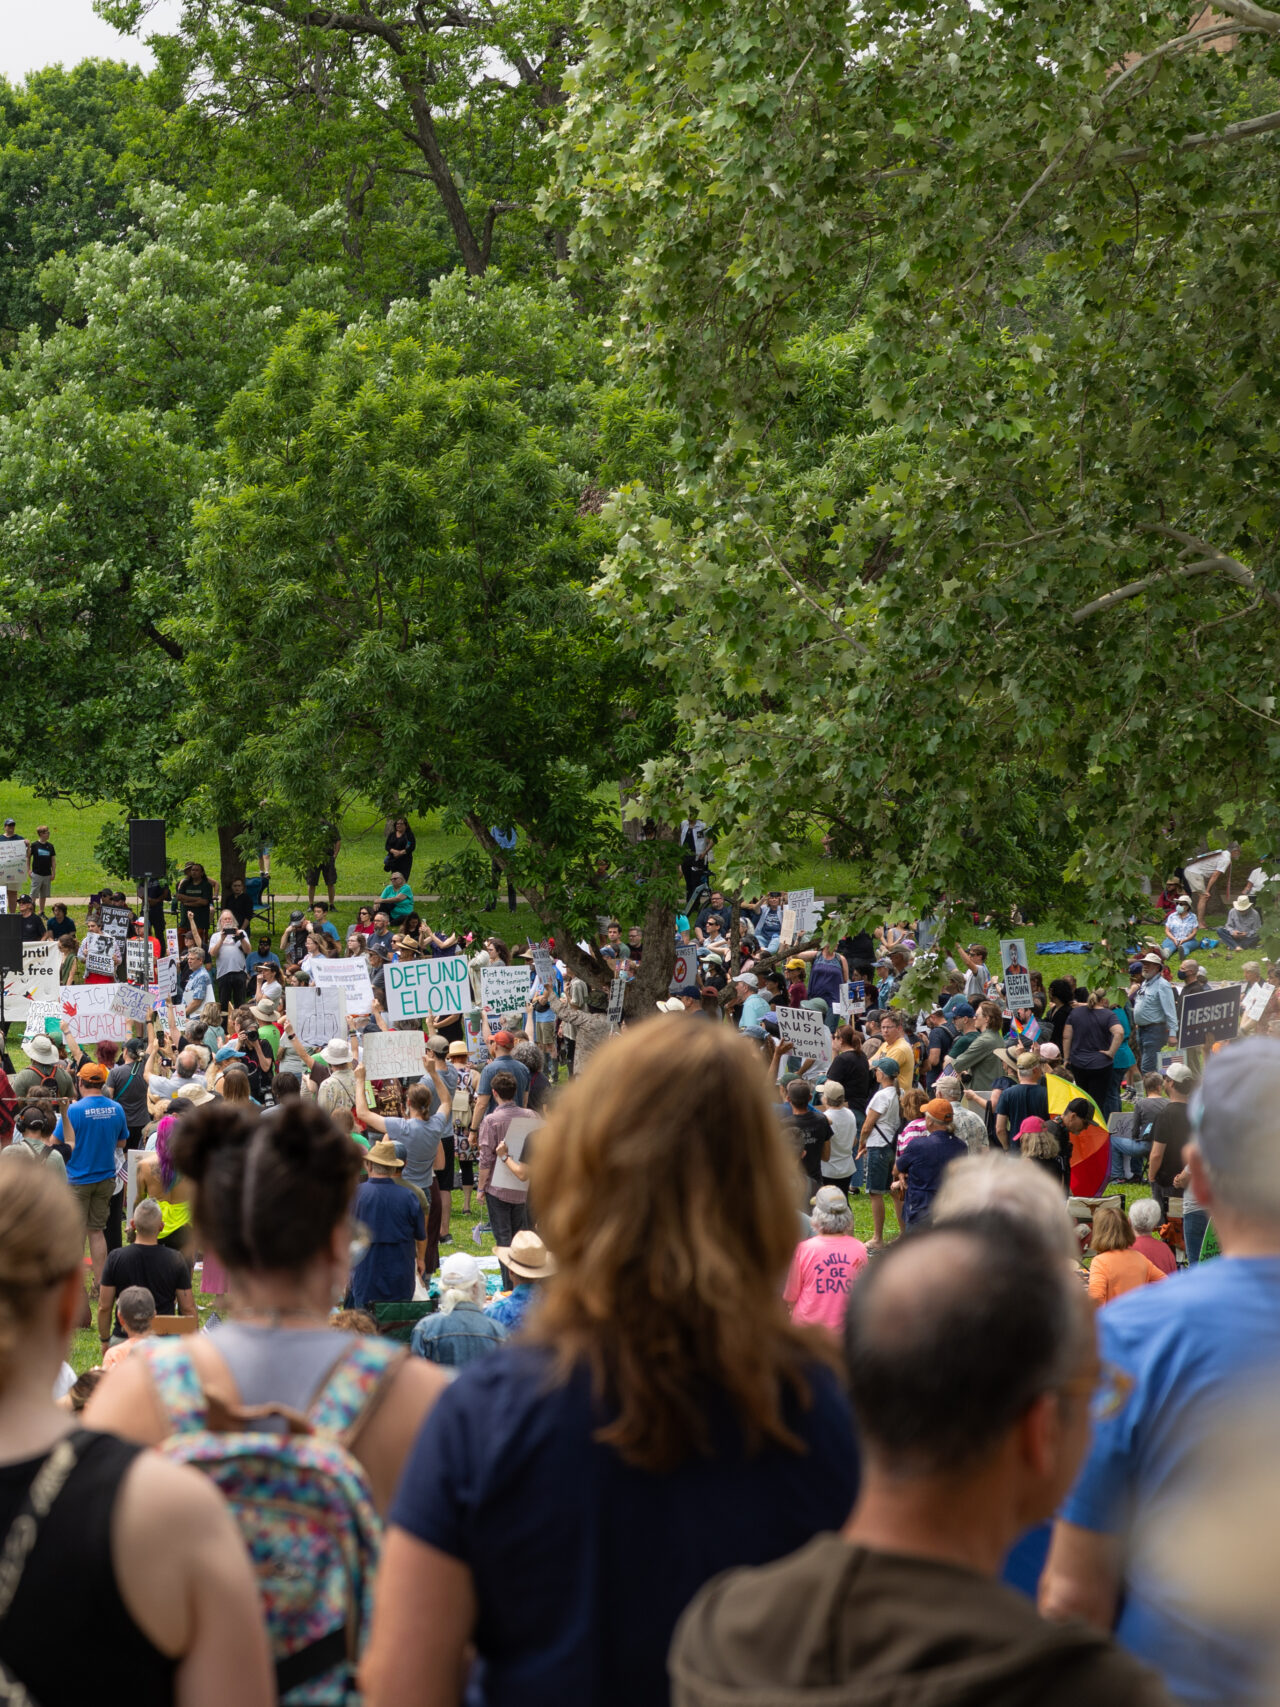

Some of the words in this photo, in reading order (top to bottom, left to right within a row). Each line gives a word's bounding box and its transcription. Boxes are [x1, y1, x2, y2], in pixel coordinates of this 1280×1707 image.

[102, 914, 111, 923] IS
[112, 908, 130, 917] ENEMY
[119, 917, 128, 926] AT
[88, 954, 112, 966] RELEASE
[28, 963, 54, 976] free
[389, 958, 468, 990] DEFUND
[482, 968, 498, 978] First
[500, 968, 513, 977] they
[1007, 975, 1022, 985] ELECT
[1023, 975, 1028, 984] A
[117, 986, 146, 1002] STAY
[1008, 985, 1030, 996] CLOWN
[121, 998, 150, 1012] WOKE
[400, 985, 462, 1016] ELON
[487, 997, 508, 1010] This
[508, 994, 526, 1004] time
[111, 1004, 128, 1013] NOT
[780, 1008, 816, 1022] SINK
[1186, 1001, 1236, 1027] RESIST!
[780, 1021, 823, 1037] MUSK
[782, 1032, 825, 1048] Boycott
[792, 1047, 817, 1059] Tesla
[84, 1106, 116, 1116] #RESIST
[814, 1264, 825, 1275] I
[823, 1252, 851, 1267] WILL
